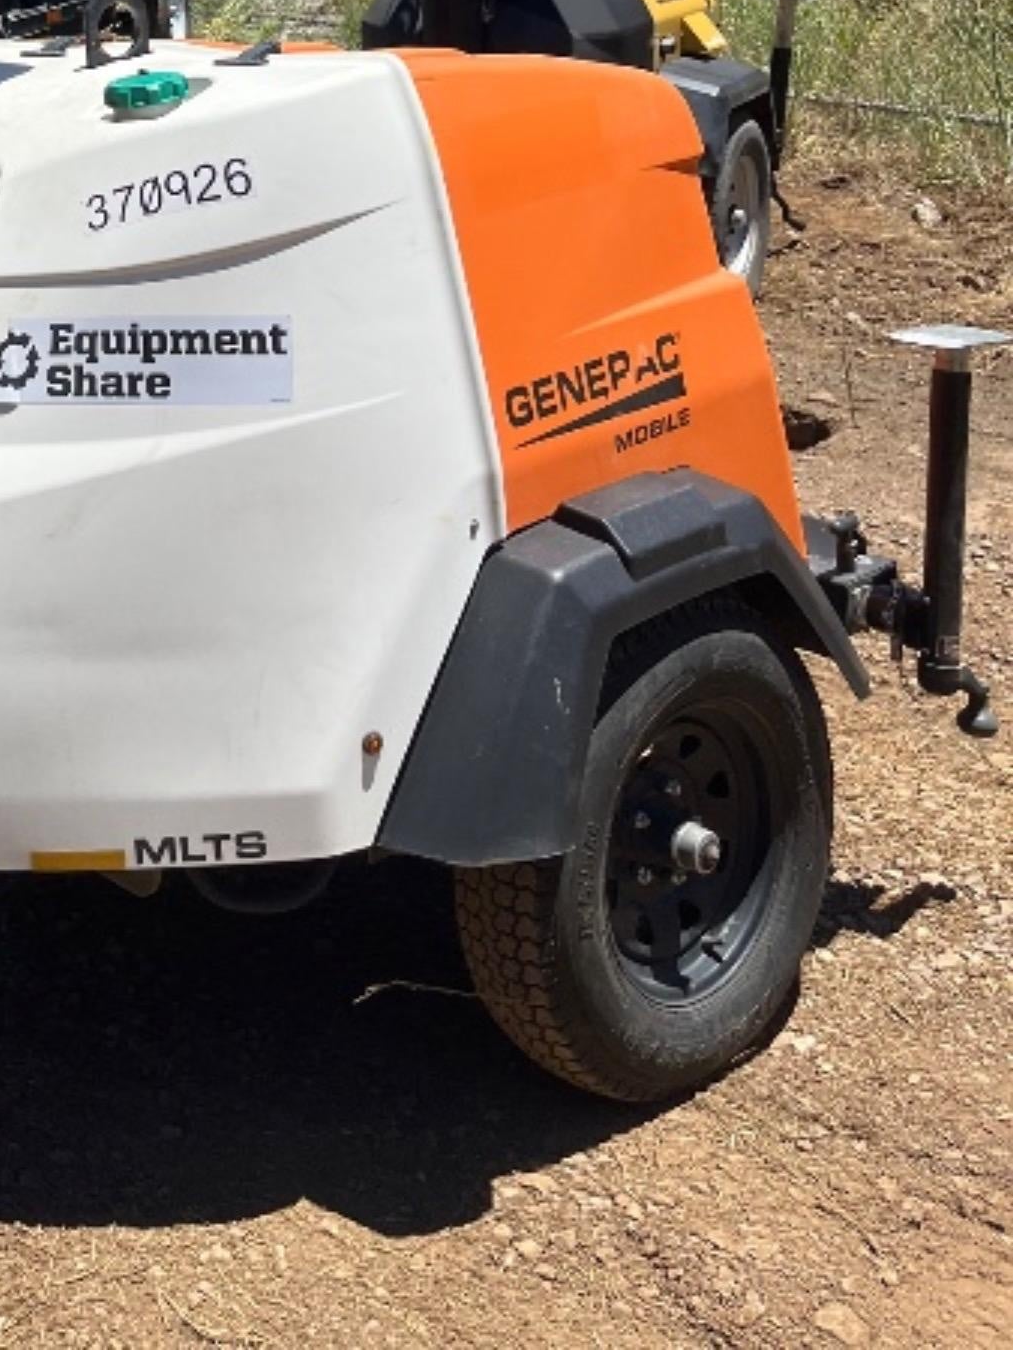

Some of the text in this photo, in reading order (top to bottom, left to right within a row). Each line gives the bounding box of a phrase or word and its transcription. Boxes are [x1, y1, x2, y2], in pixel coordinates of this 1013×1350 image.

[86, 157, 253, 231] 370926
[48, 323, 288, 364] Equipment
[46, 364, 172, 398] Share
[614, 407, 690, 453] MOBILE
[133, 831, 267, 865] MLTS
